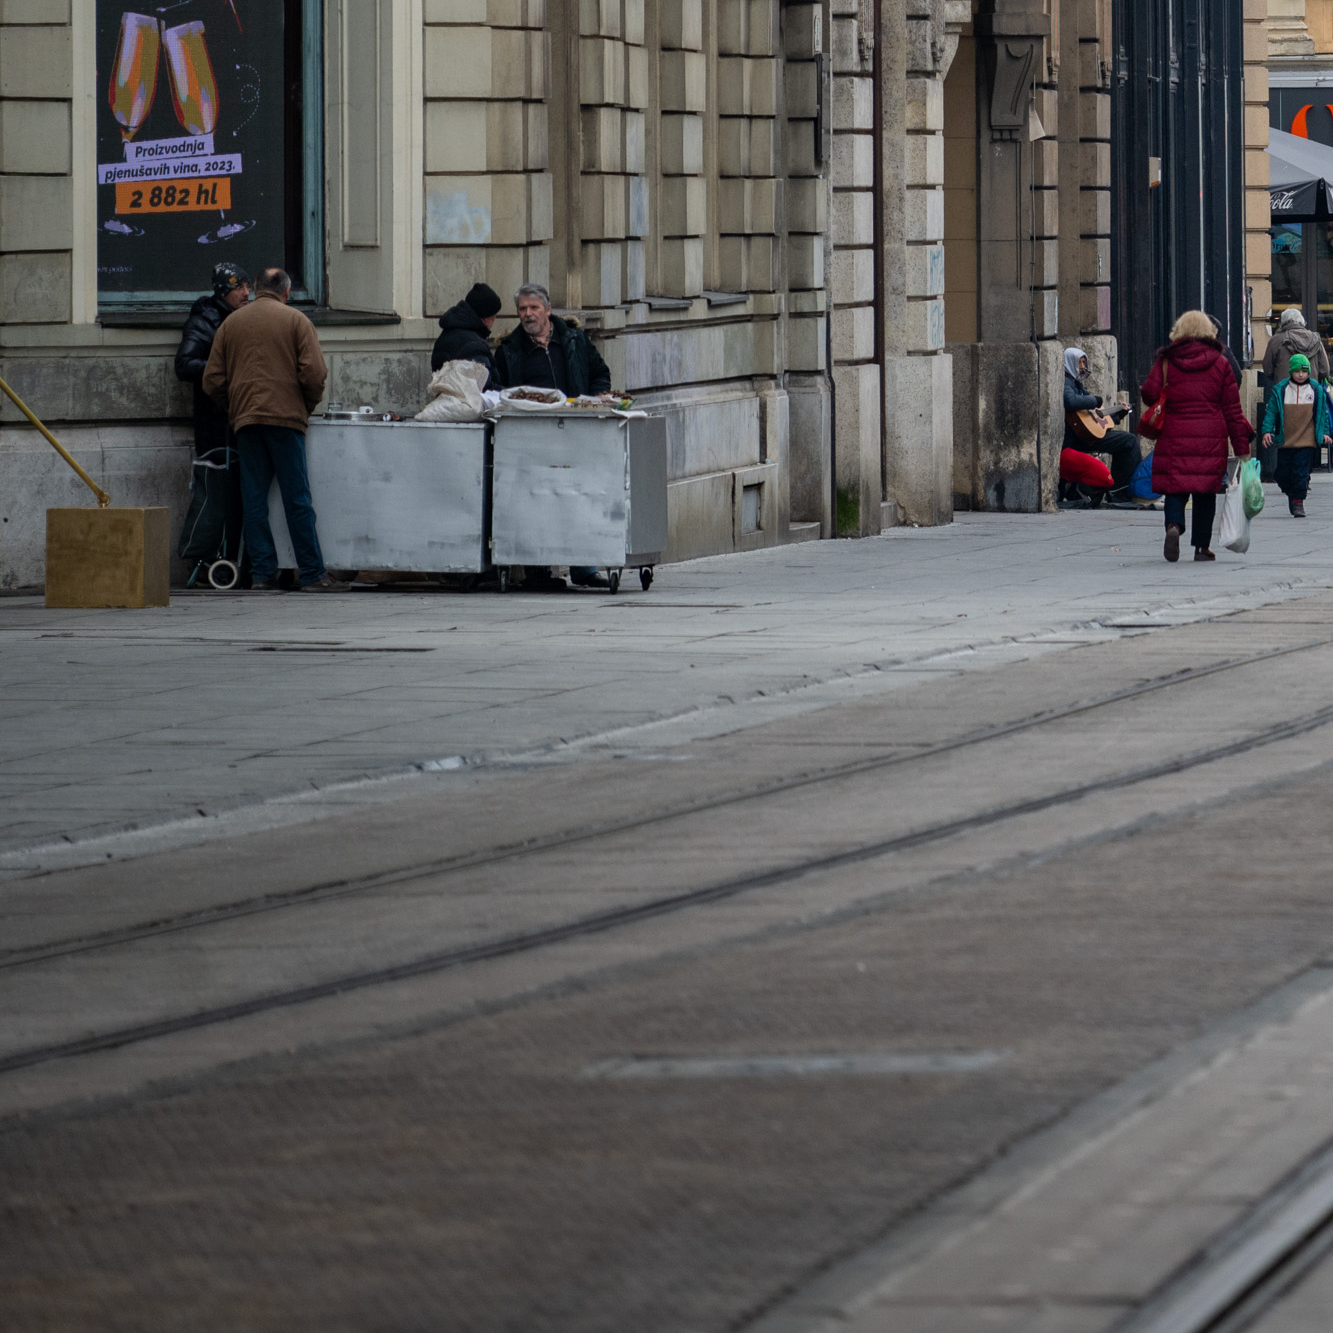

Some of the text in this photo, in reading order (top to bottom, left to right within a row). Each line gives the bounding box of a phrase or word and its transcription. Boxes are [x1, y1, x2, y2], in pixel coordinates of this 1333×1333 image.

[135, 140, 205, 158] Proizvodnja
[105, 160, 236, 183] pjenušavih vina, 2023.
[129, 182, 218, 208] 2 882 hl
[1270, 190, 1297, 210] ola
